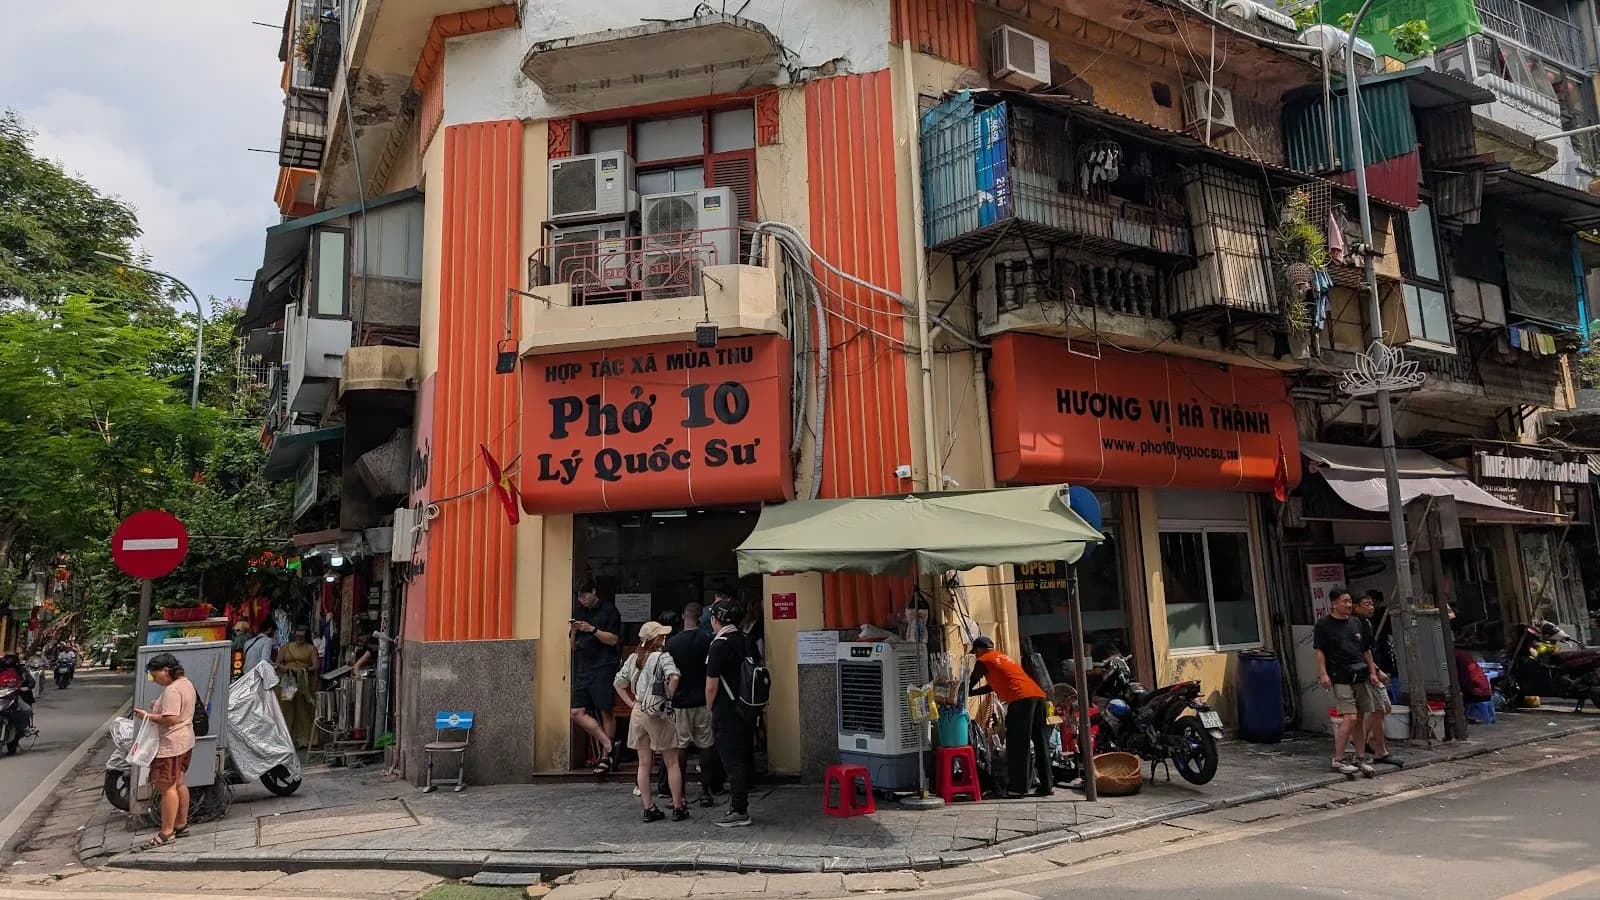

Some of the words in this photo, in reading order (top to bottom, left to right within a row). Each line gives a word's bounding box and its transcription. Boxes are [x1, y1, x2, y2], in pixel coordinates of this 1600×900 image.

[545, 363, 583, 383] HỢP
[589, 357, 624, 378] TÁC
[666, 348, 710, 371] MÙA
[715, 346, 754, 367] THU
[548, 385, 657, 440] Phở
[680, 381, 750, 429] 10
[1056, 388, 1142, 422] HƯƠNG
[1148, 400, 1172, 433] VỊ
[1178, 398, 1204, 428] HÀ
[1208, 403, 1271, 434] THÀNH
[537, 449, 583, 485] Lý
[594, 437, 691, 482] Quốc
[704, 437, 761, 467] Sư
[1021, 560, 1056, 575] OPEN
